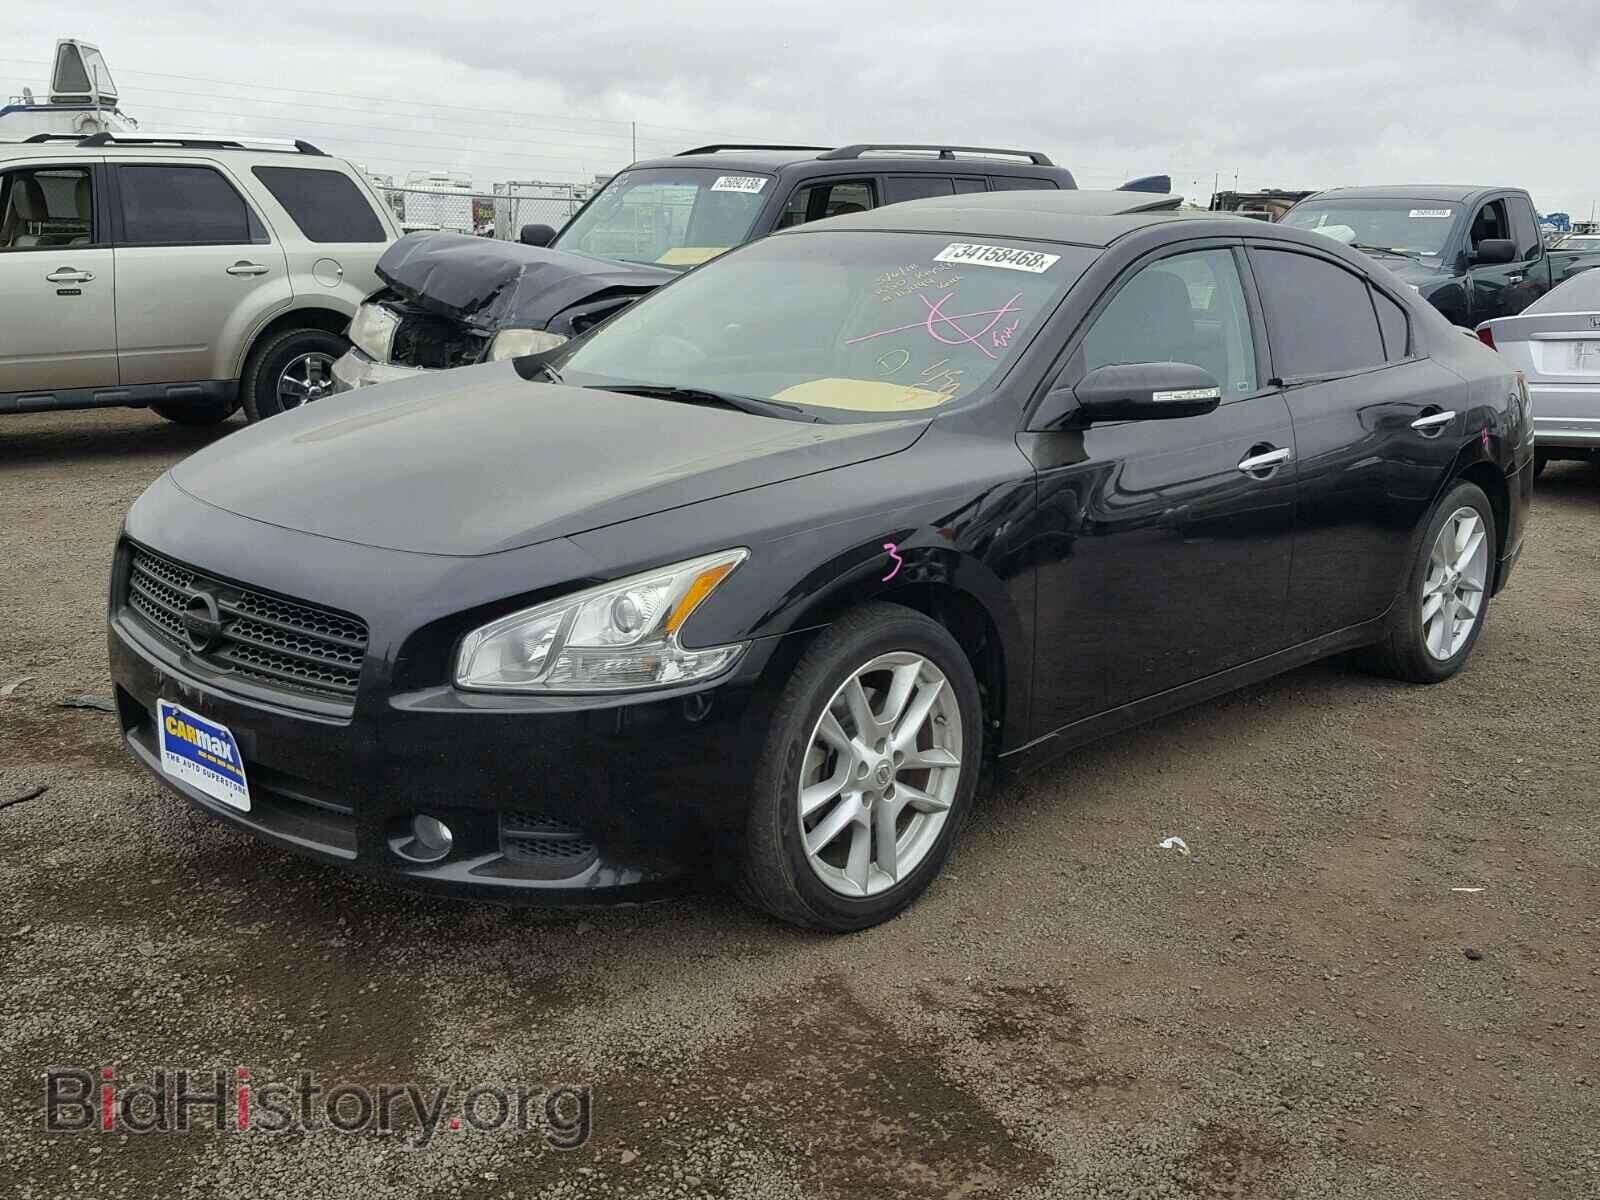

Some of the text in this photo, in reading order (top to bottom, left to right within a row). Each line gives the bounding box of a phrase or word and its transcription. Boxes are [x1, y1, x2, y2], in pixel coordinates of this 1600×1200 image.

[882, 543, 903, 582] 3
[166, 752, 180, 763] THE
[183, 758, 201, 773] AUTO
[202, 768, 247, 795] SUPERSTORE
